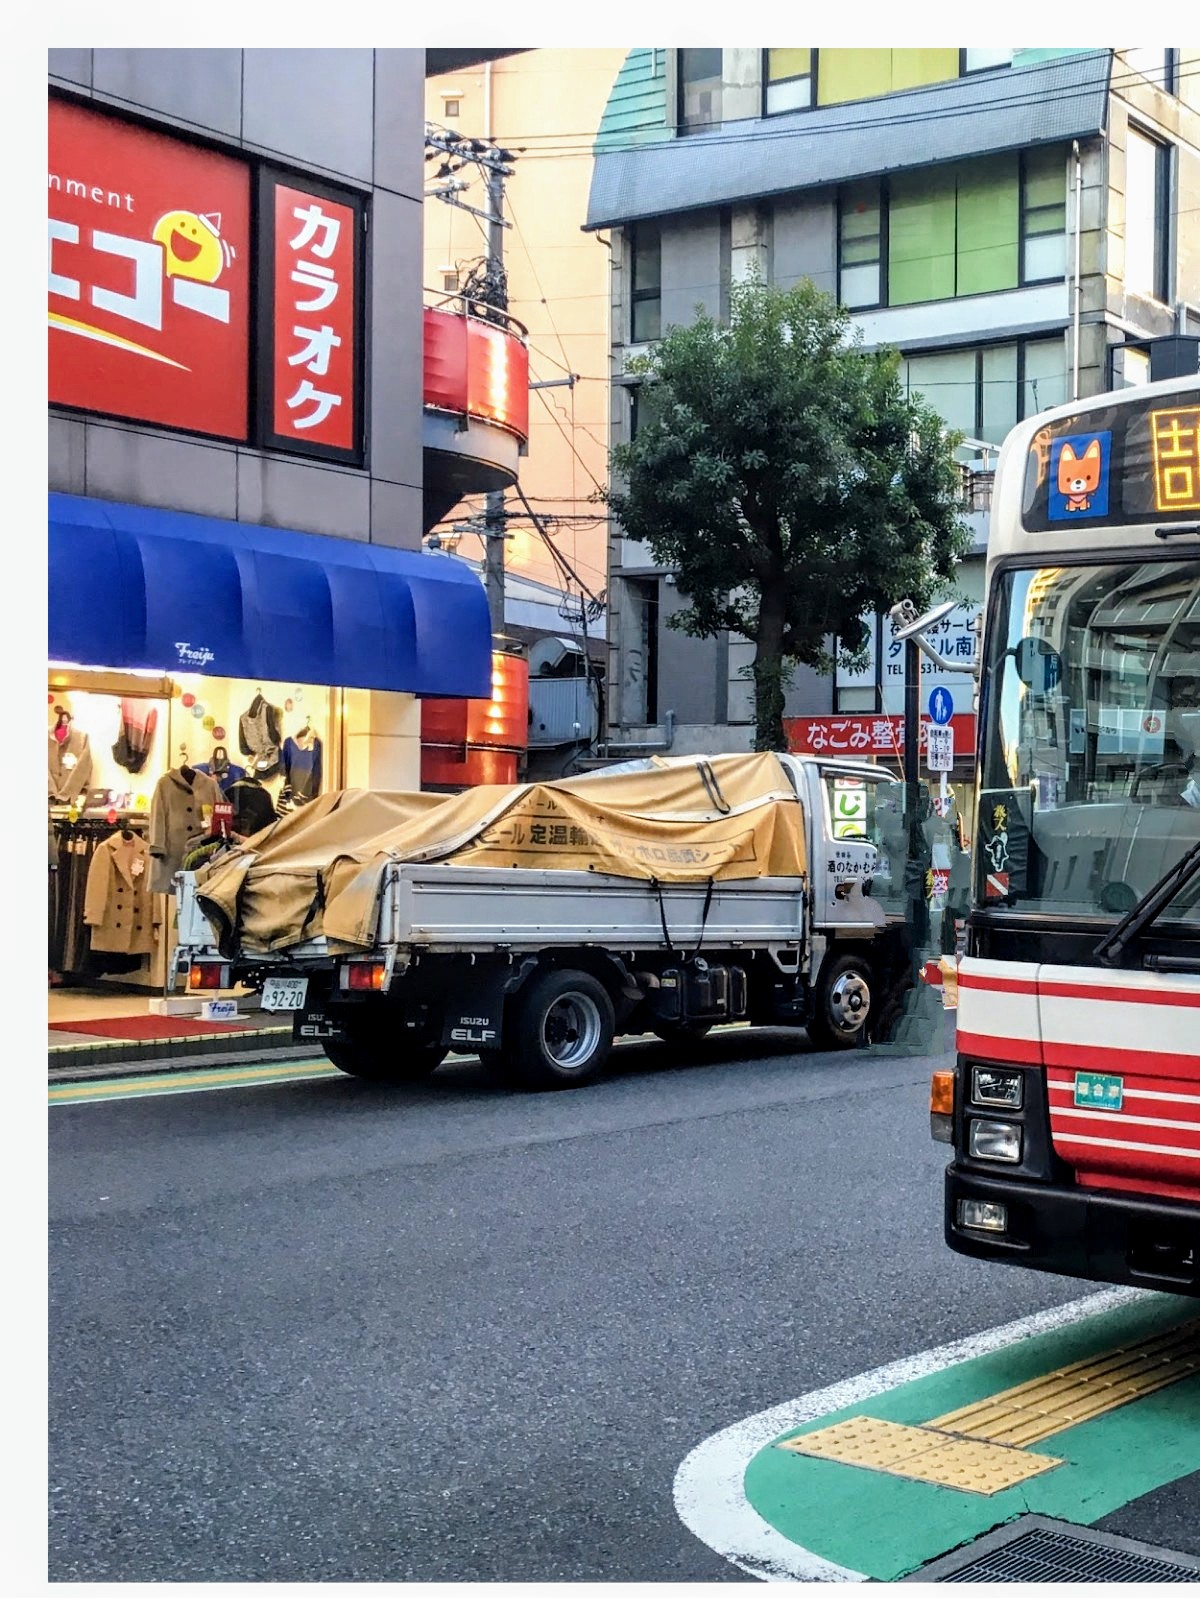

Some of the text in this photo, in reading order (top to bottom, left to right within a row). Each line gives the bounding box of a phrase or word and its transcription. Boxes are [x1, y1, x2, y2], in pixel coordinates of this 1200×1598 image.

[286, 204, 342, 429] カラオケ
[215, 805, 232, 814] SALE
[270, 990, 304, 1007] 92-20
[460, 1016, 490, 1026] ISUZU
[451, 1028, 496, 1042] ELF
